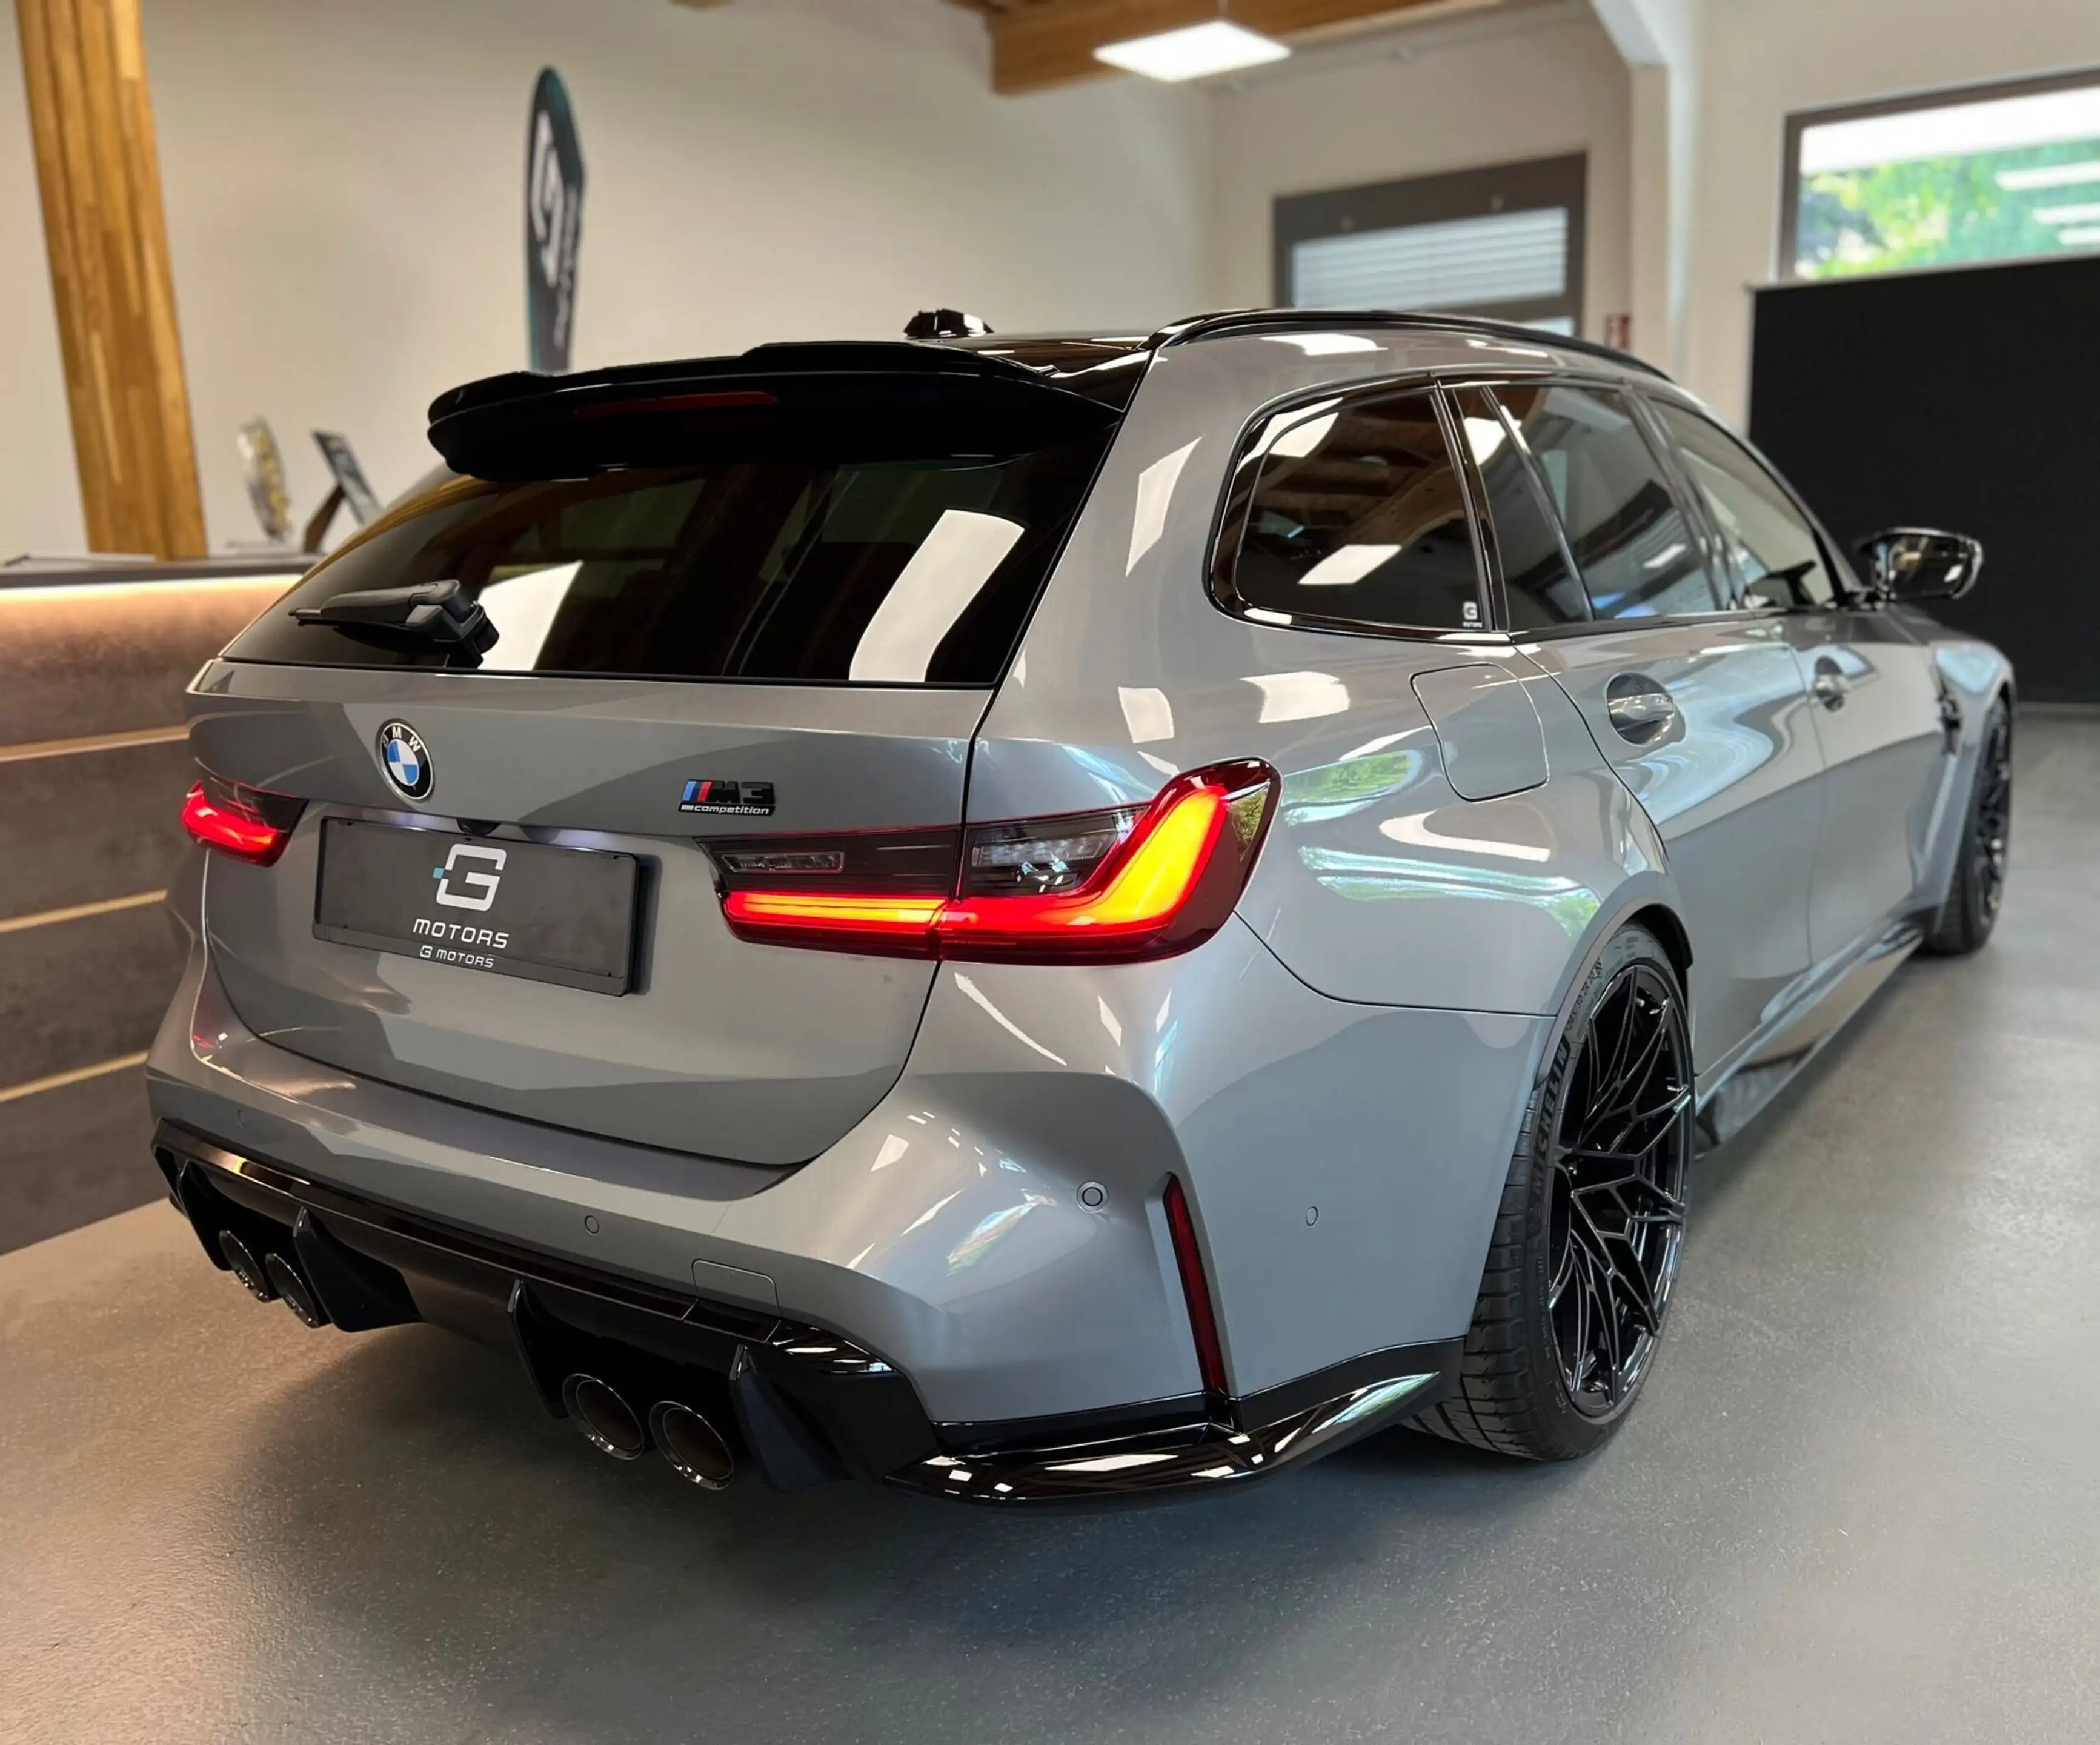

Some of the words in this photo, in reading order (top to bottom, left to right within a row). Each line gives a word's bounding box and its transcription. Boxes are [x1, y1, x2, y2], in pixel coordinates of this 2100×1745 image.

[694, 805, 769, 815] competition
[433, 843, 507, 911] G
[413, 918, 509, 949] MOTORS
[435, 949, 494, 969] MOTORS
[1530, 1040, 1568, 1195] MICHELIN
